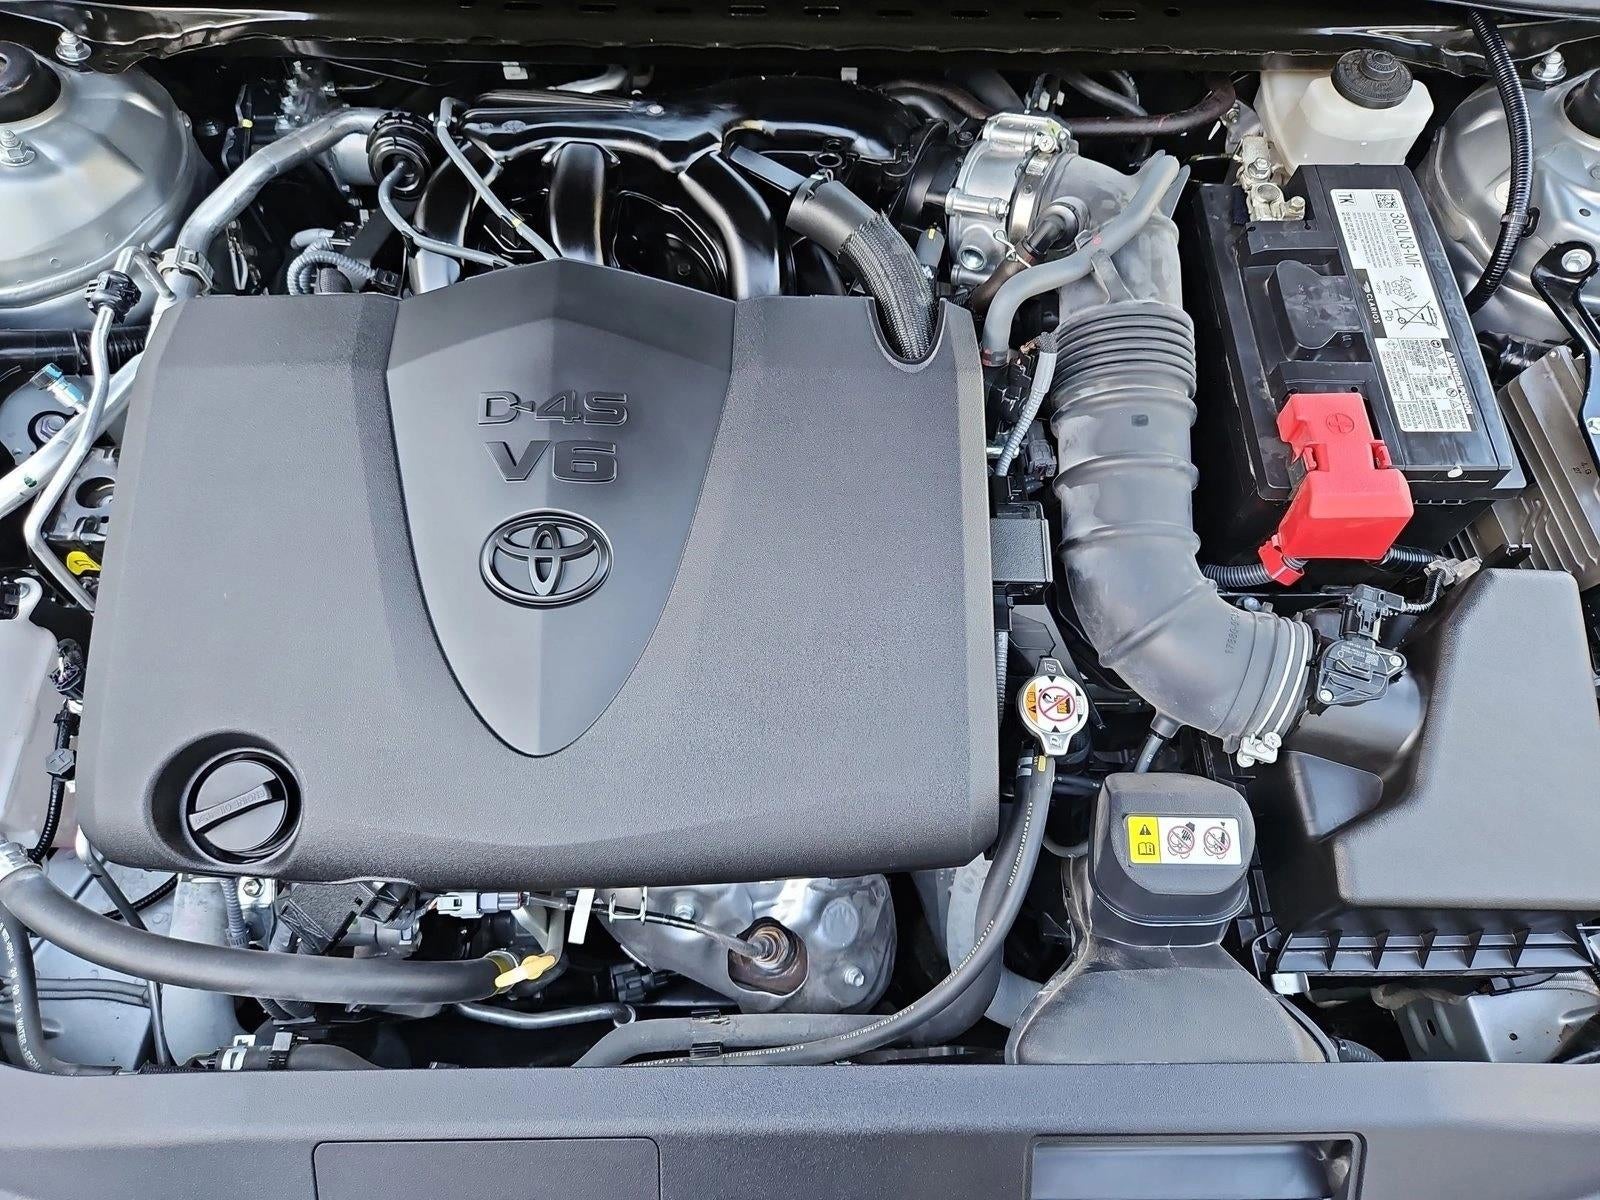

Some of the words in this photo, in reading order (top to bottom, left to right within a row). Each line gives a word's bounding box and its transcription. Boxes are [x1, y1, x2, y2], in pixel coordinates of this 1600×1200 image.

[1337, 193, 1355, 205] TK
[1389, 212, 1423, 268] 380LN3-MF
[1366, 293, 1382, 325] CLARIOS
[1383, 309, 1394, 321] Pb
[477, 390, 628, 427] D-4S
[484, 439, 618, 485] V6
[16, 1017, 27, 1046] WATER
